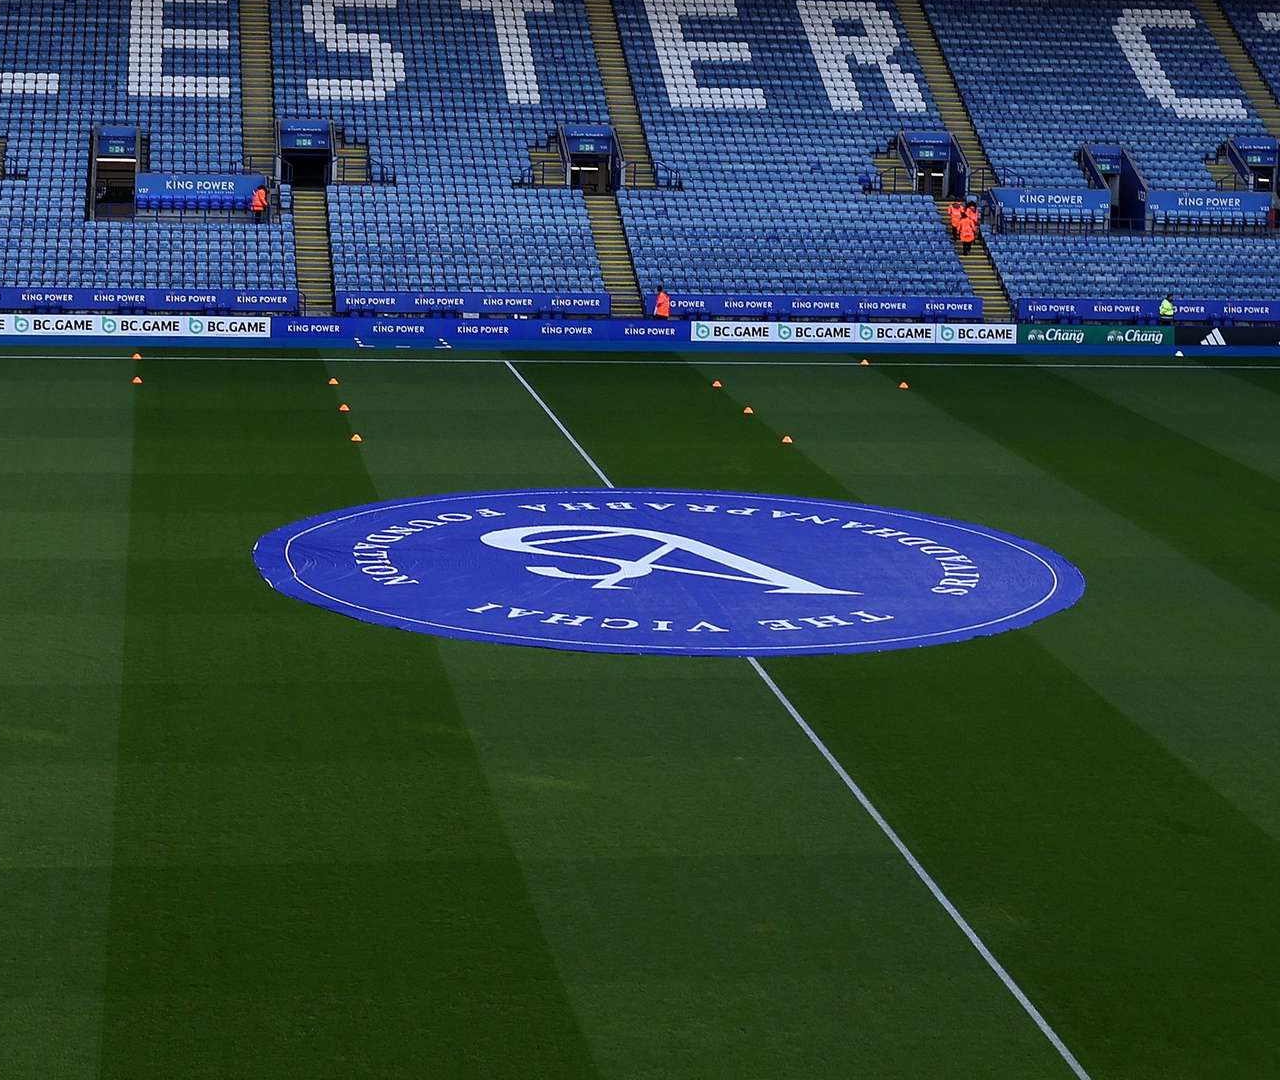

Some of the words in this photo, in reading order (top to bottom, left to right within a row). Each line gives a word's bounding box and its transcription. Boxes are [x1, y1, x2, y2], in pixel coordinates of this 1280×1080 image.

[166, 181, 194, 190] KING
[197, 181, 234, 192] POWER
[1020, 195, 1045, 204] KING
[1048, 195, 1083, 204] POWER
[1179, 198, 1203, 206] KING
[1207, 198, 1240, 207] POWER
[34, 320, 92, 331] BC.GAME
[121, 321, 180, 332] BC.GAME
[208, 321, 266, 333] BC.GAME
[458, 326, 479, 334] KING
[714, 327, 769, 337] BC.GAME
[796, 327, 851, 338] BC.GAME
[877, 328, 931, 339] BC.GAME
[959, 329, 1012, 339] BC.GAME
[1045, 329, 1084, 344] Chang
[1124, 330, 1163, 344] Chang
[353, 508, 506, 586] FOUNDATION
[467, 602, 730, 633] VICHAI
[758, 610, 895, 631] THE
